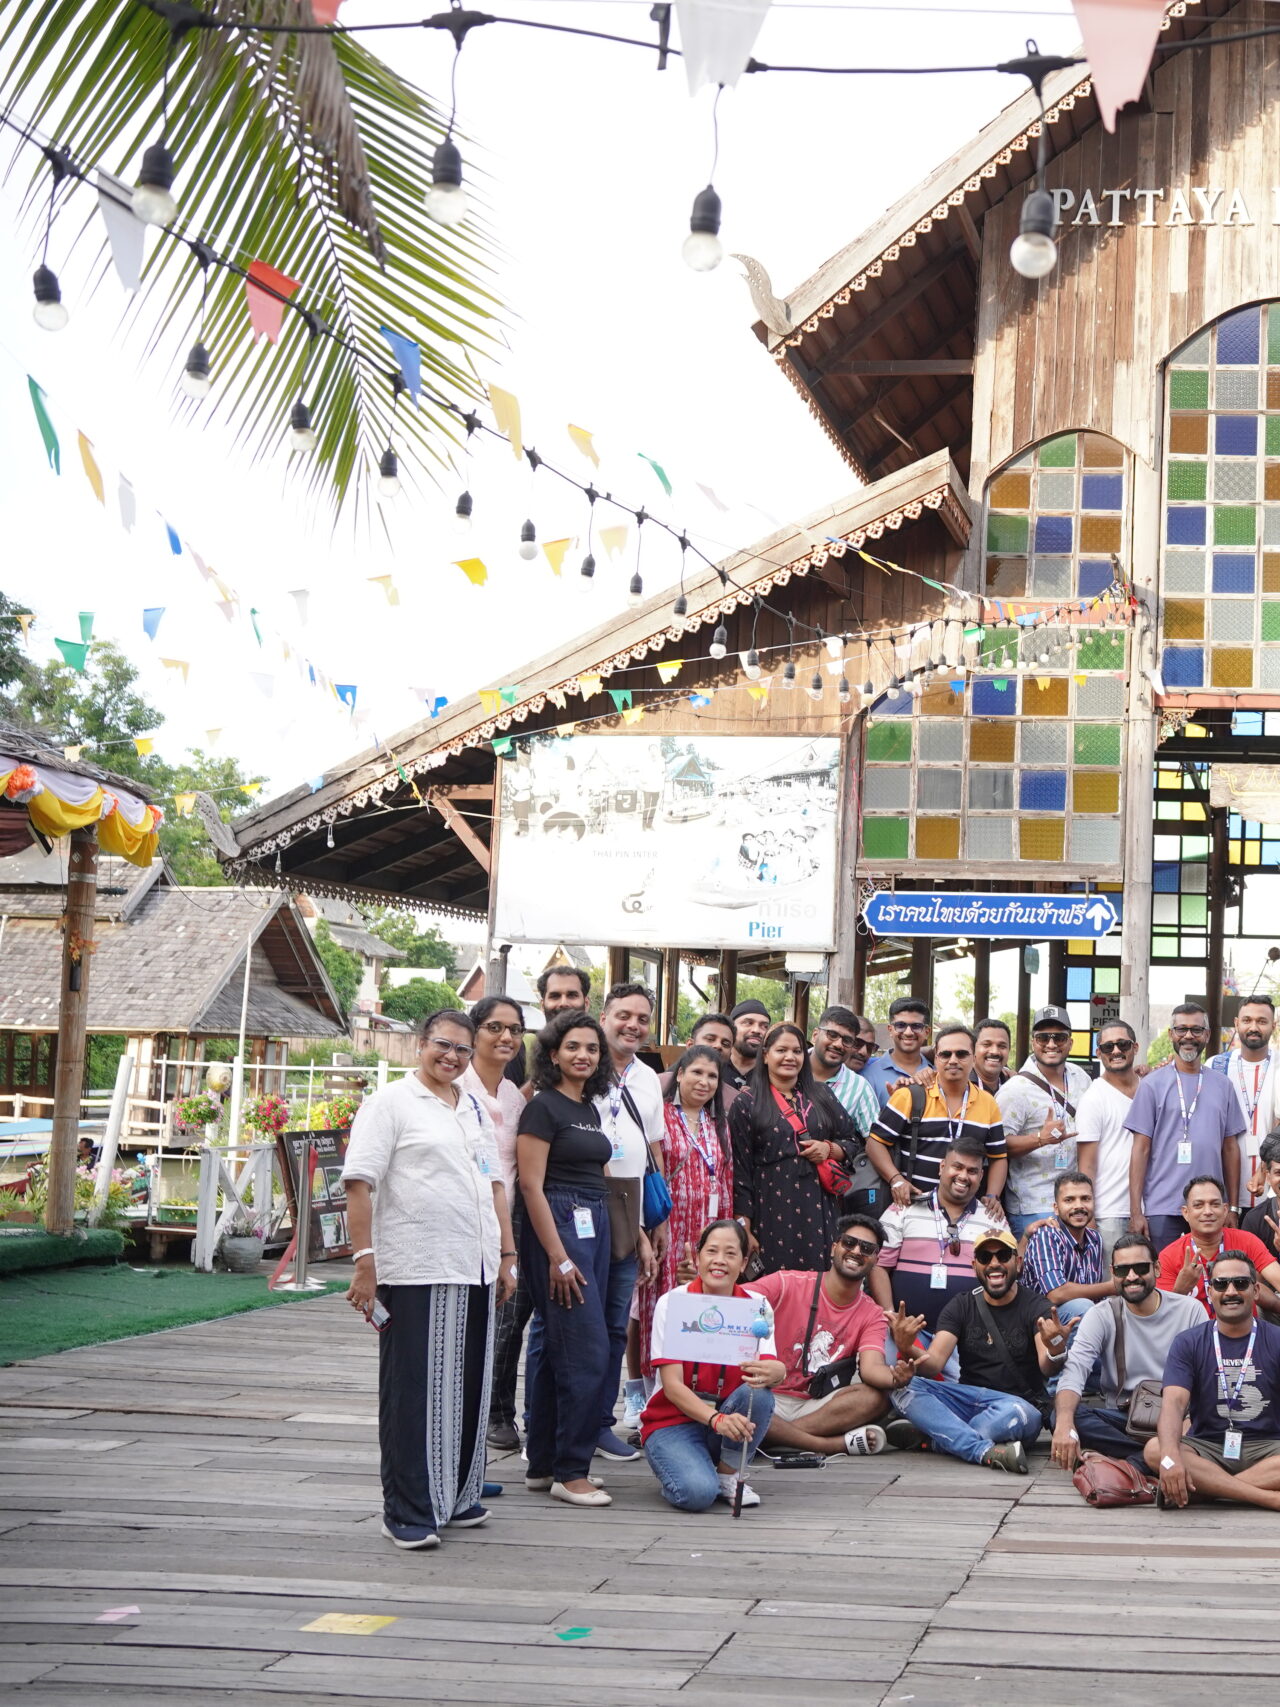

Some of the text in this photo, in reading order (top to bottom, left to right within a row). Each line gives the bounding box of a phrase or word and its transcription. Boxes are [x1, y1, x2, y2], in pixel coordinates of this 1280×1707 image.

[1050, 187, 1255, 228] PATTAYA
[877, 897, 1088, 925] เราคนไทยด้วยกันเข้าฟรี
[748, 921, 784, 939] Pier
